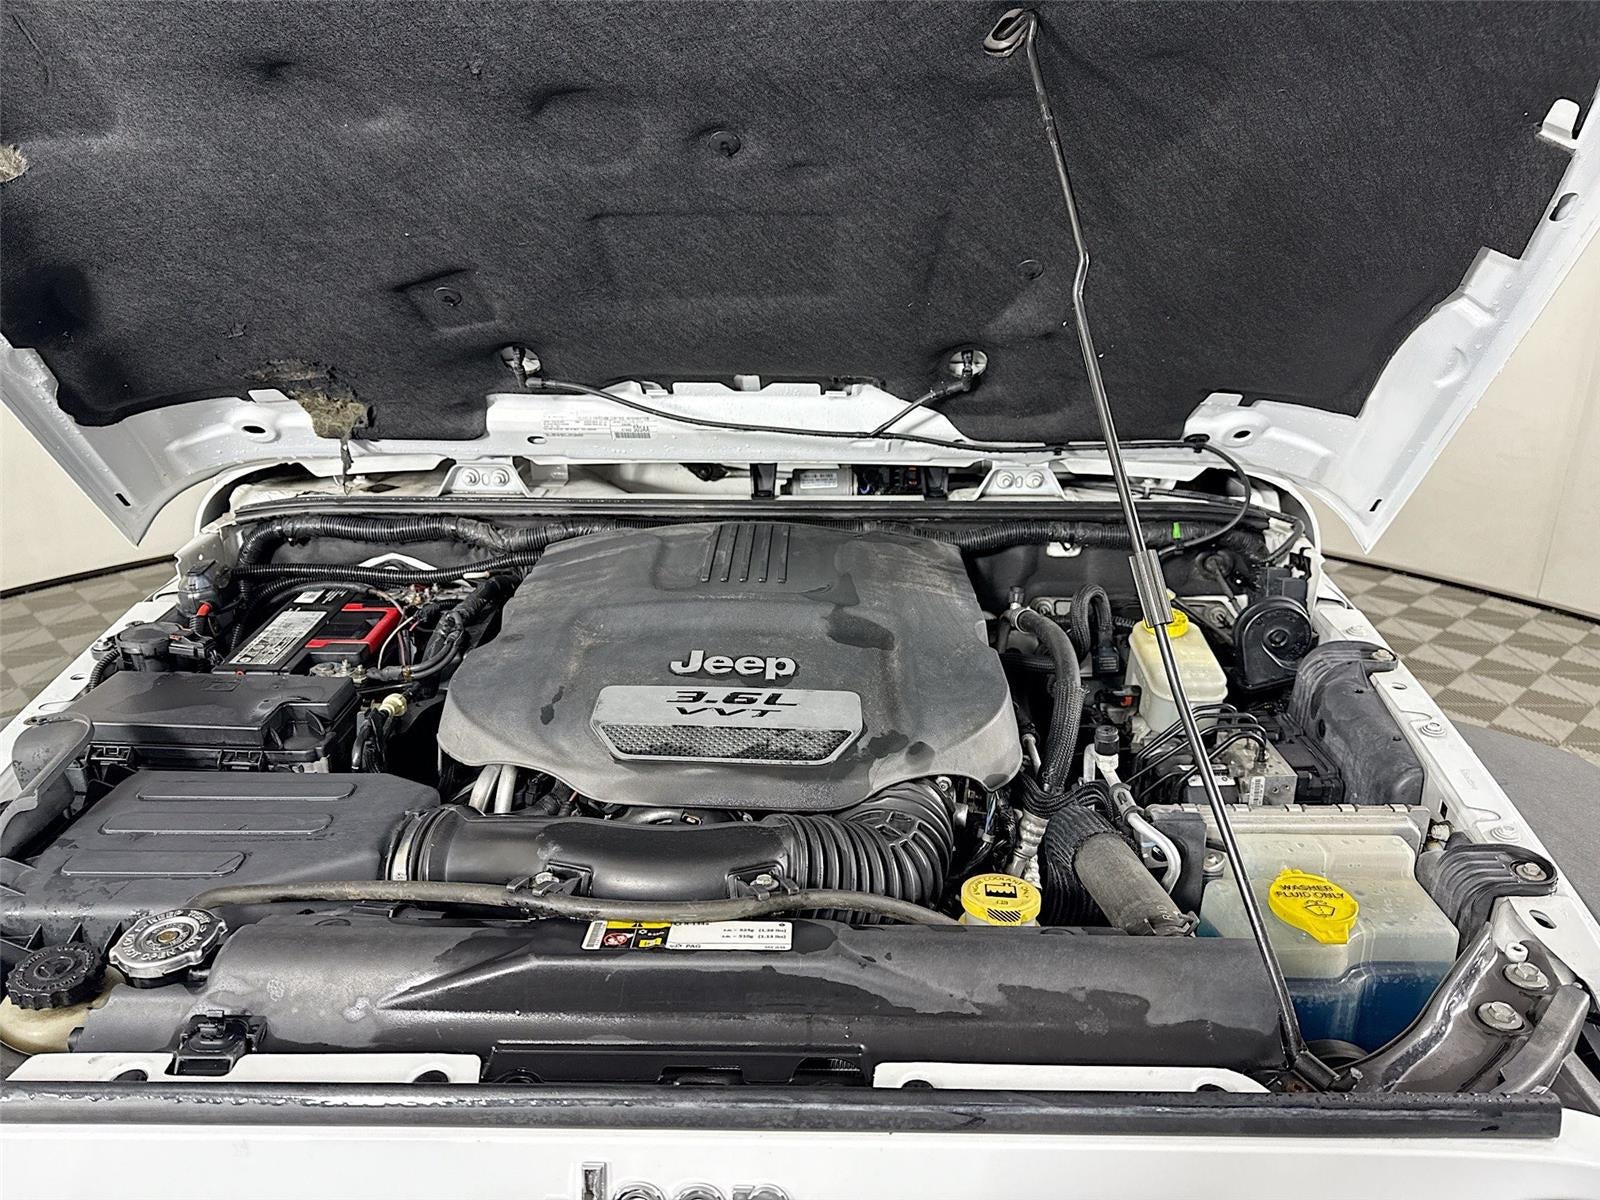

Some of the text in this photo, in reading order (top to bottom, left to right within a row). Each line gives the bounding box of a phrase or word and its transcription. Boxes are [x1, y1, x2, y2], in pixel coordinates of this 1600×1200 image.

[669, 650, 797, 680] Jeep
[666, 690, 798, 706] 3.6L
[676, 706, 782, 718] VVT
[1280, 884, 1335, 892] WASHER
[1312, 891, 1344, 899] ONLY
